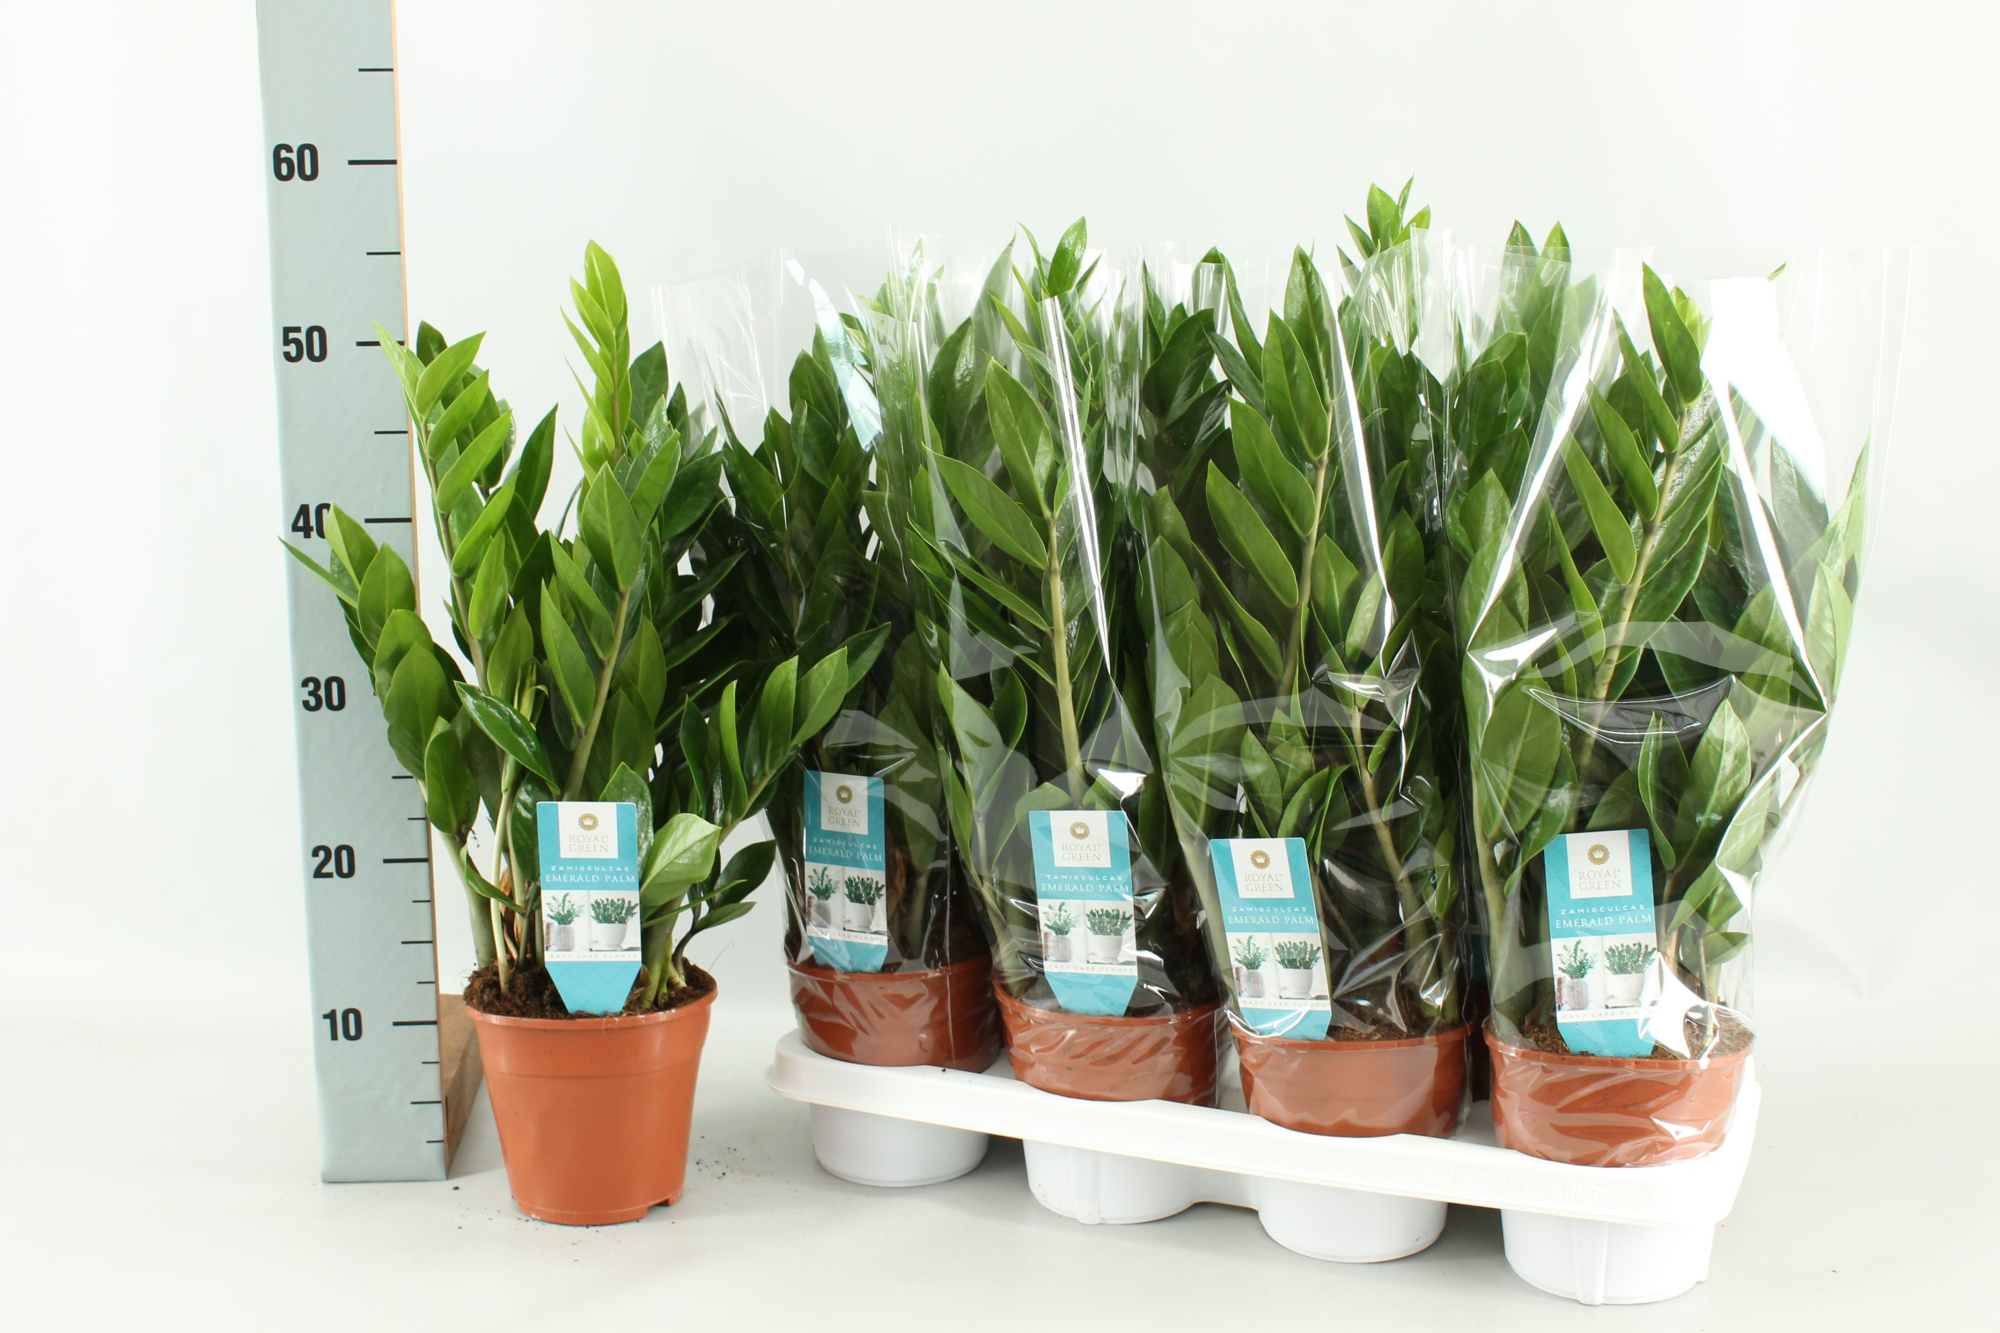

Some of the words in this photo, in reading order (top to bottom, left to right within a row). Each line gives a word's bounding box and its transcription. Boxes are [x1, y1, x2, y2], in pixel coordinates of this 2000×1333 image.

[272, 143, 319, 182] 60
[282, 325, 328, 363] 50
[301, 676, 347, 712] 30
[828, 816, 860, 827] GREEN
[568, 844, 608, 853] GREEN
[813, 837, 877, 850] ZAMIOCULCAS
[808, 846, 853, 858] EMERALD
[856, 852, 882, 861] PALM
[1062, 852, 1101, 861] GREEN
[311, 844, 356, 879] 20
[545, 874, 600, 882] EMERALD
[605, 875, 635, 883] PALM
[1041, 883, 1094, 892] EMERALD
[1099, 884, 1129, 893] PALM
[1245, 883, 1284, 892] GREEN
[1579, 880, 1621, 891] GREEN
[1560, 904, 1645, 915] ZAMIOCULCAS
[1228, 915, 1280, 924] EMERALD
[1284, 916, 1315, 924] PALM
[1555, 916, 1613, 929] EMERALD
[1619, 914, 1652, 925] PALM
[322, 1007, 363, 1041] 10
